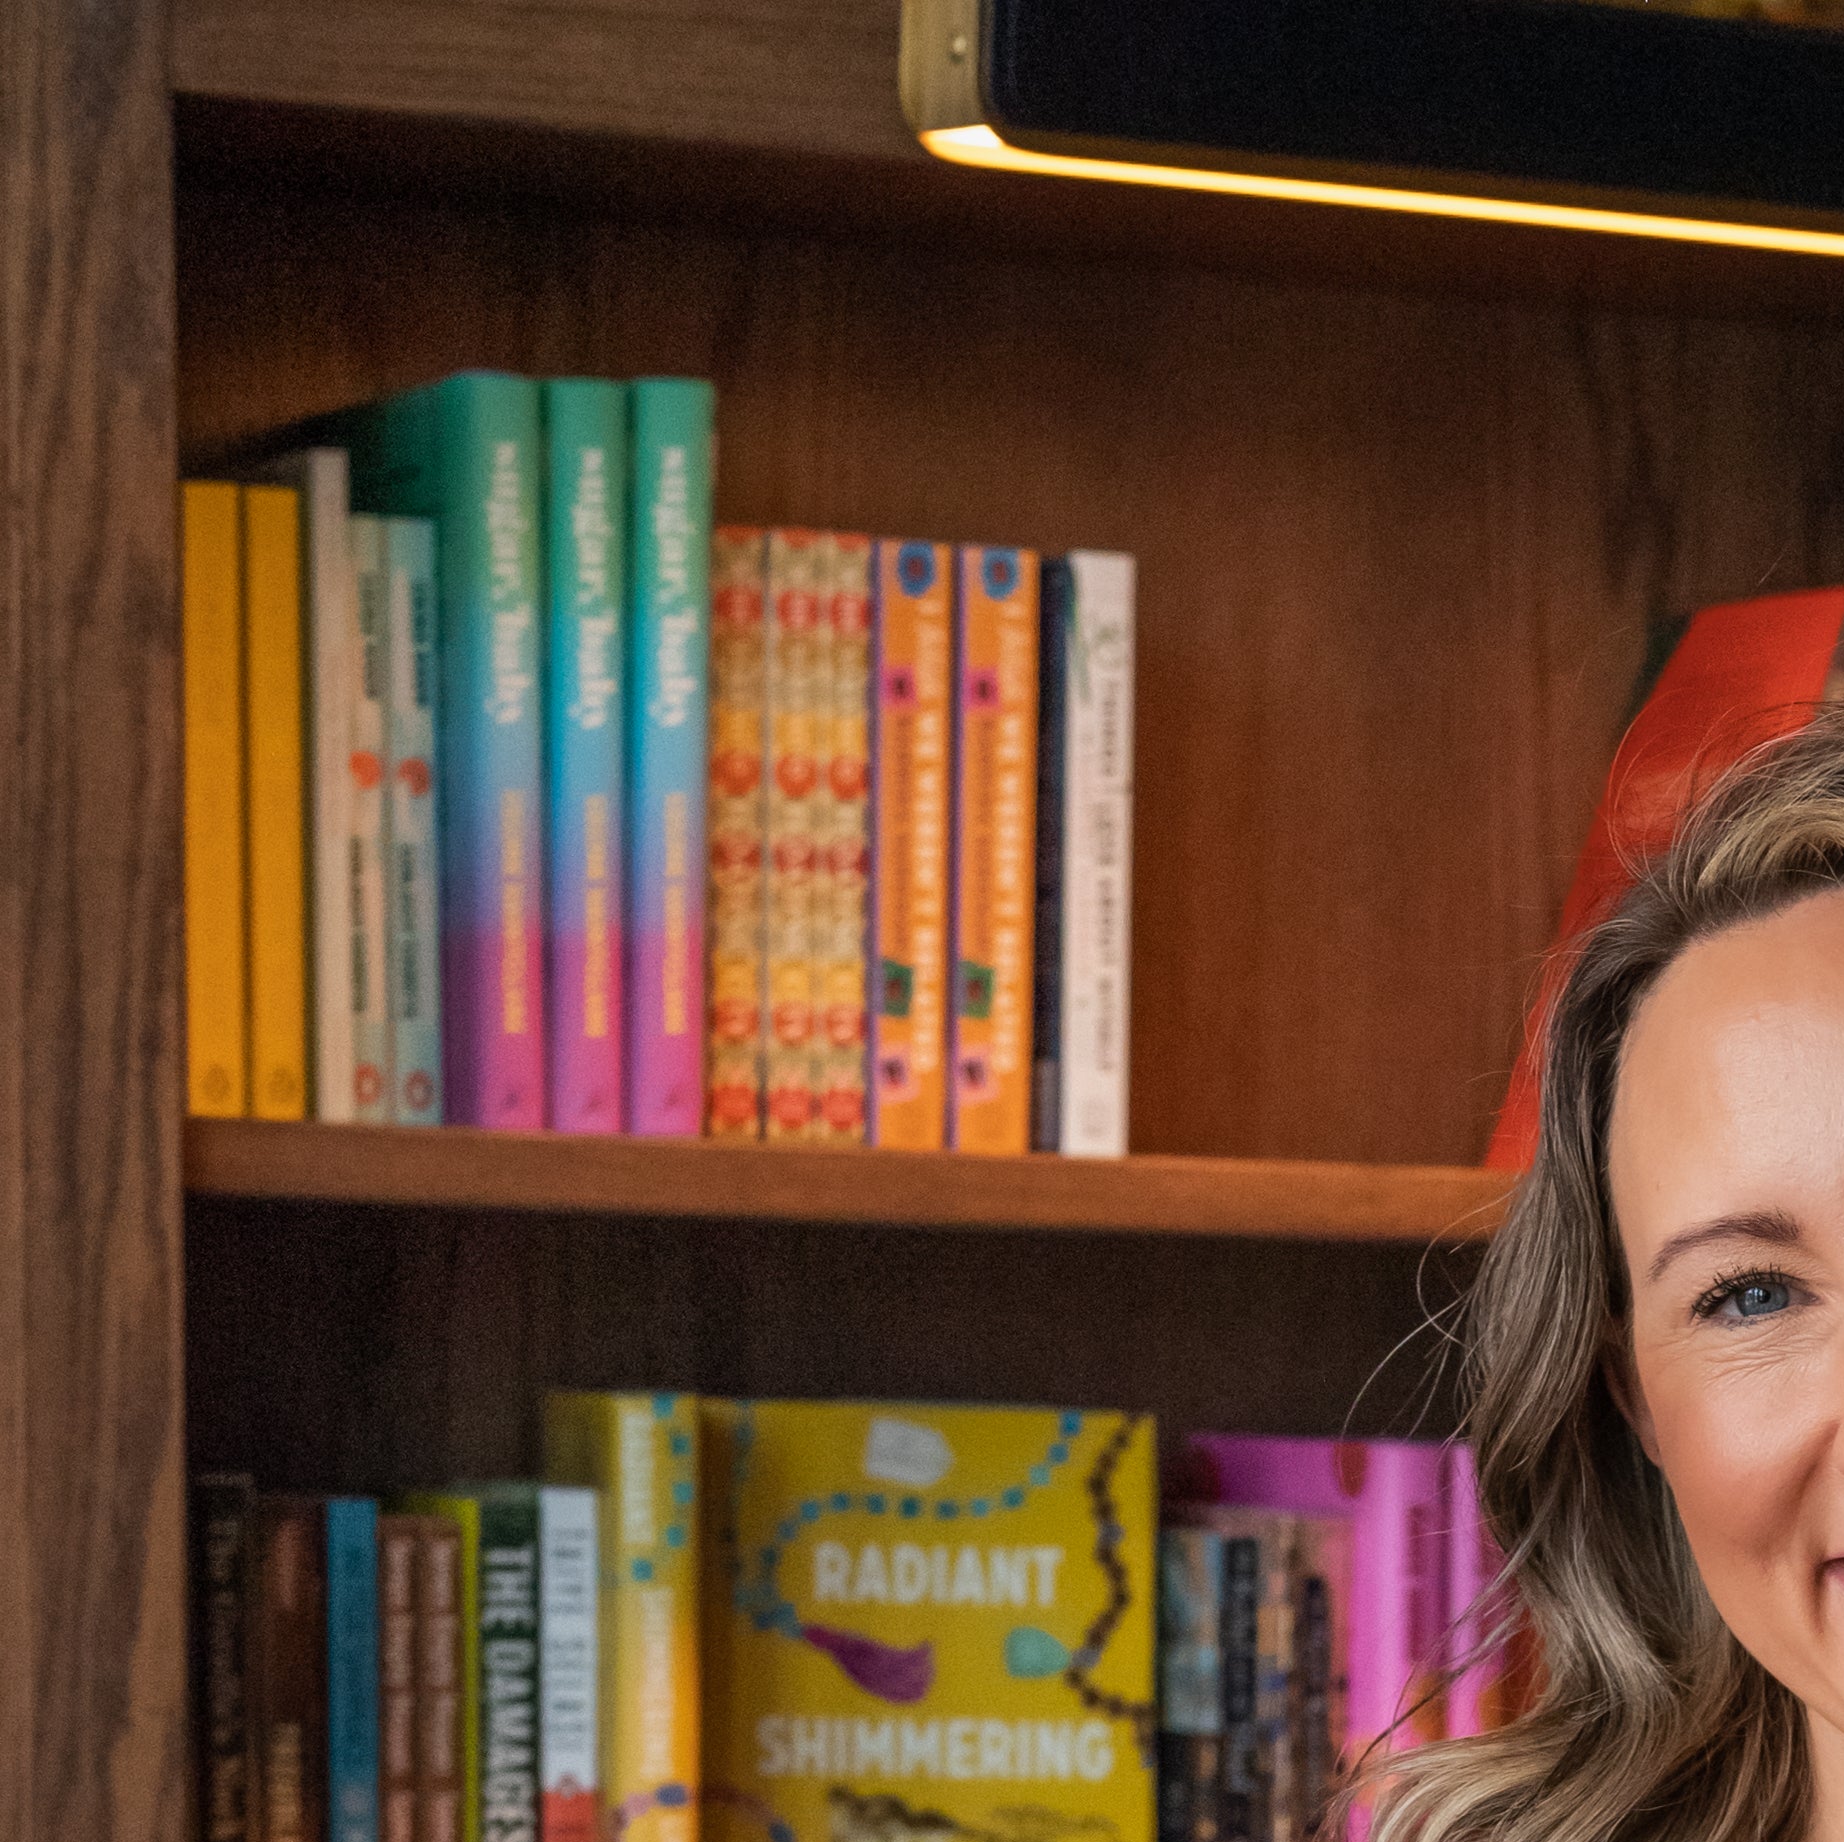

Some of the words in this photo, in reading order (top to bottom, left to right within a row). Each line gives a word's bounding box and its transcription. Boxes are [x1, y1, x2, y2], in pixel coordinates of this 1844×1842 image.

[484, 1546, 534, 1627] THE
[813, 1545, 1065, 1605] RADIANT
[755, 1716, 1115, 1782] SHIMMERING
